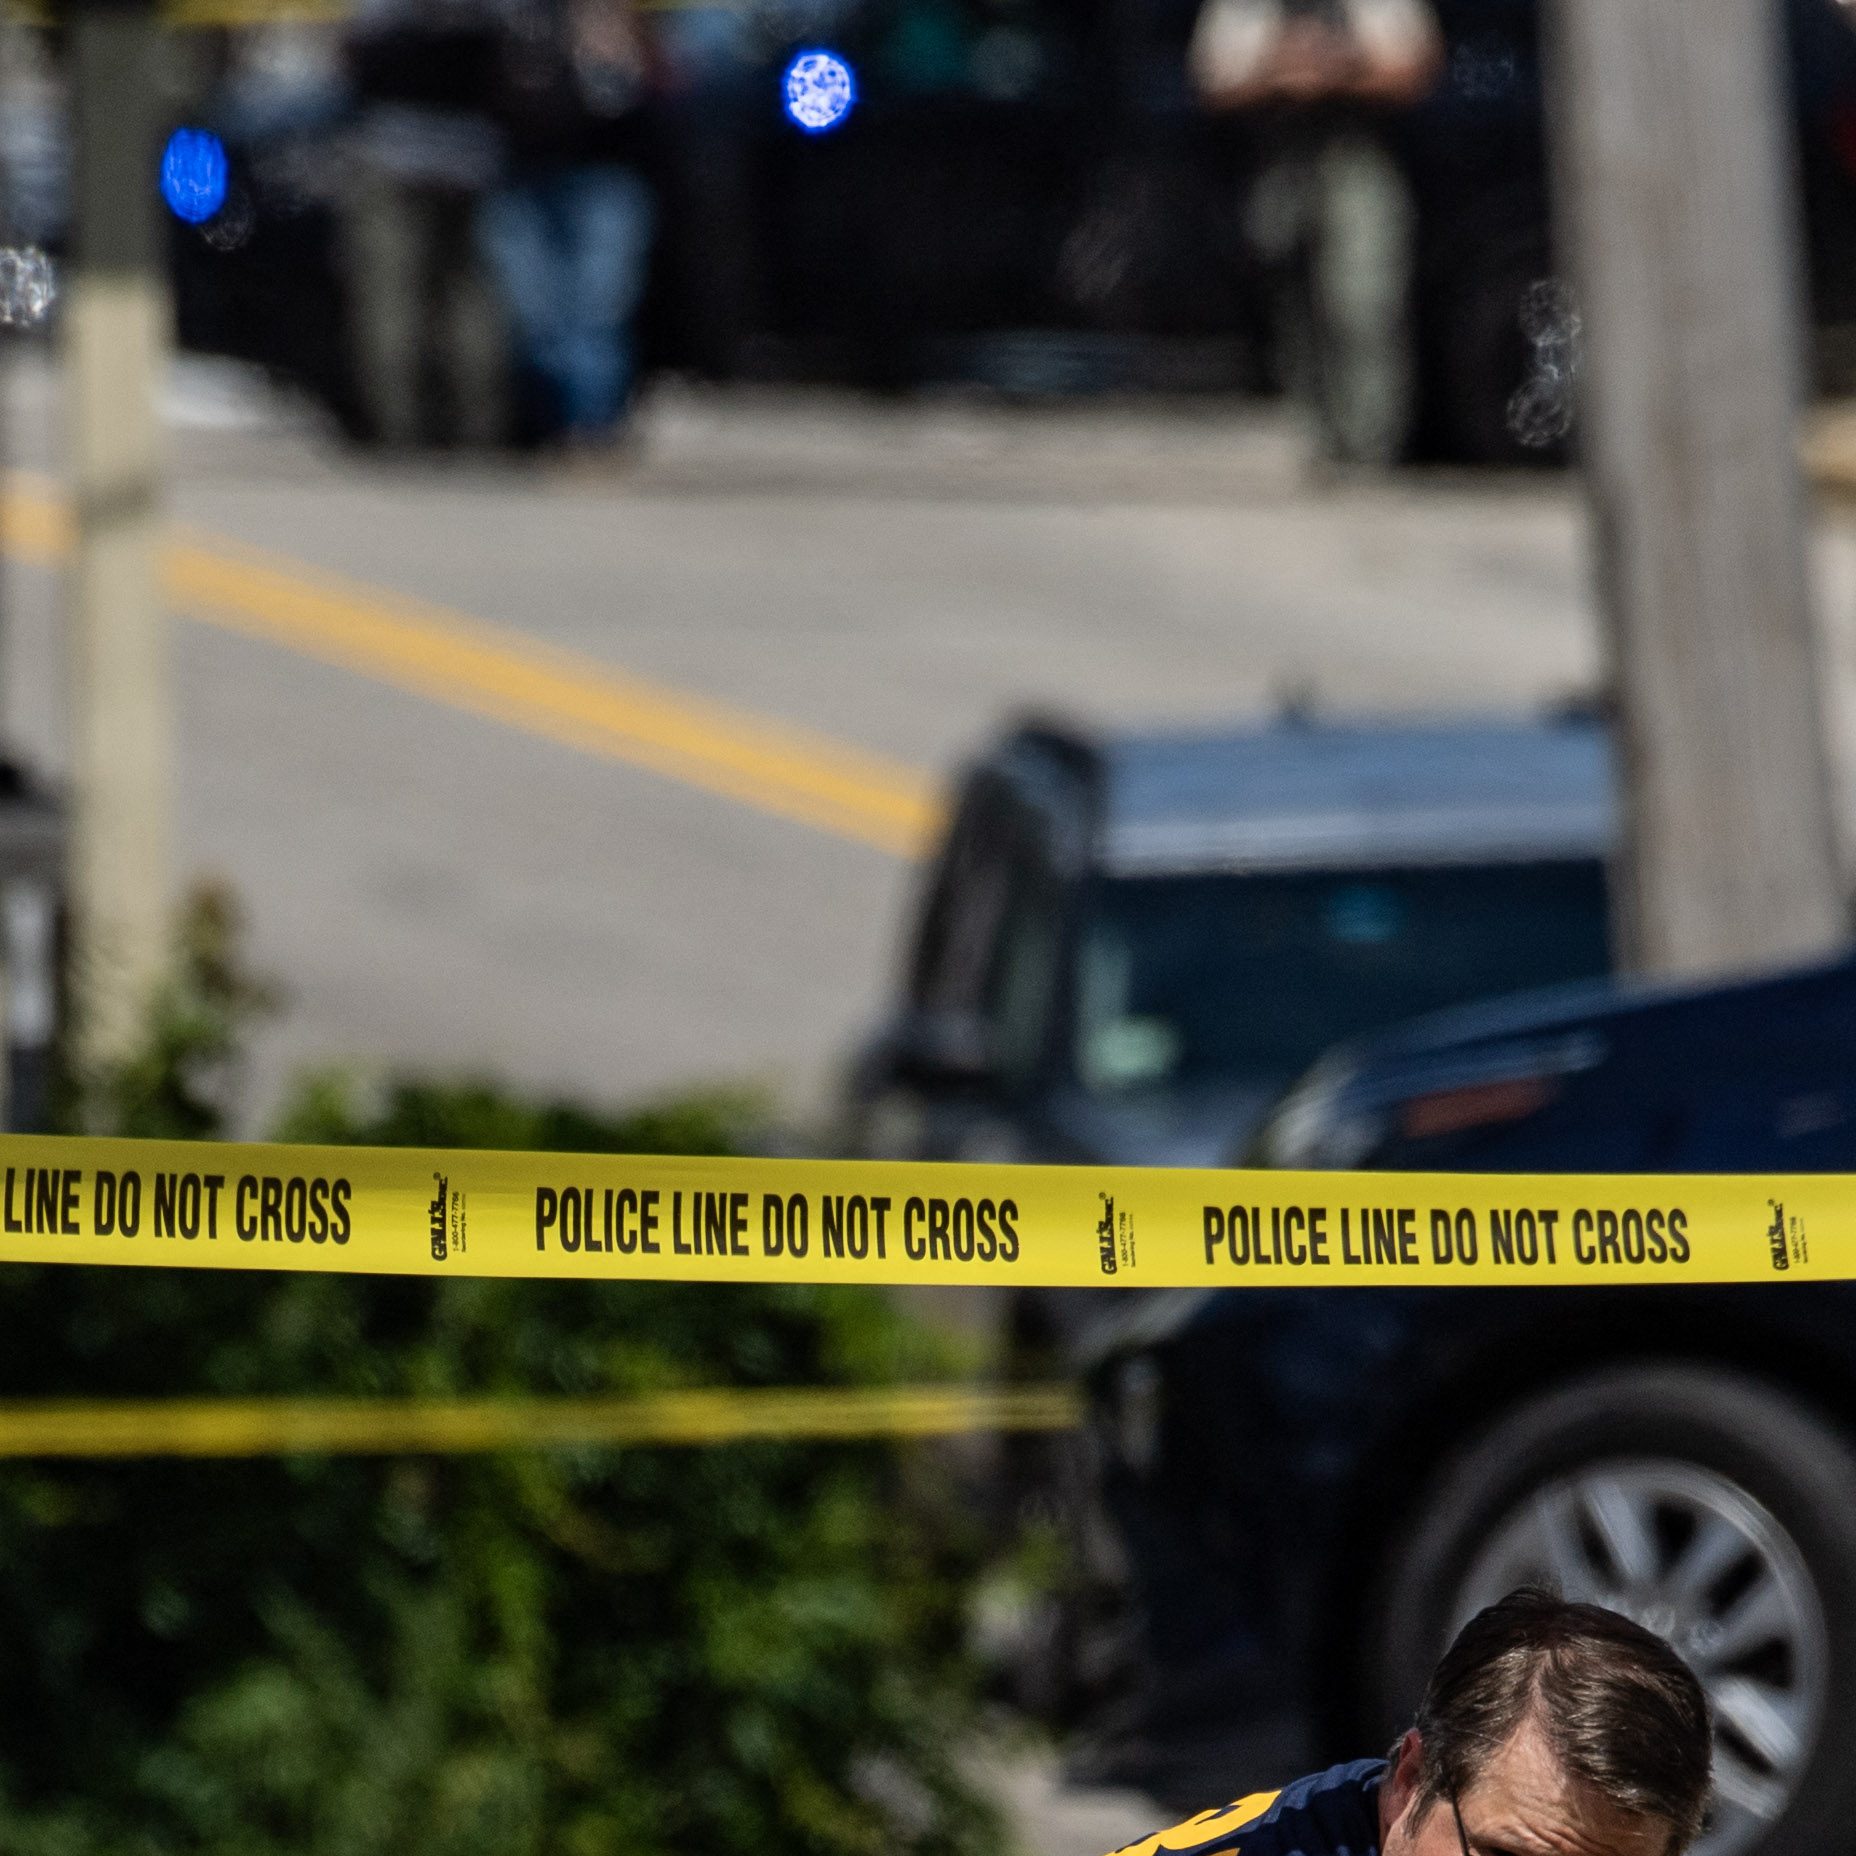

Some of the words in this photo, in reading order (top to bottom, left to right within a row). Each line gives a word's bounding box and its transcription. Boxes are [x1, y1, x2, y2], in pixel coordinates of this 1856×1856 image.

[4, 1166, 83, 1235] LINE
[94, 1168, 141, 1237] DO
[154, 1169, 225, 1240] NOT
[236, 1172, 351, 1245] CROSS
[536, 1187, 660, 1253] POLICE
[673, 1191, 749, 1255] LINE
[763, 1193, 808, 1258] DO
[822, 1195, 891, 1258] NOT
[904, 1197, 1019, 1261] CROSS
[1204, 1205, 1329, 1266] POLICE
[1341, 1208, 1419, 1264] LINE
[1431, 1208, 1477, 1265] DO
[1490, 1209, 1558, 1264] NOT
[1573, 1209, 1689, 1263] CROSS
